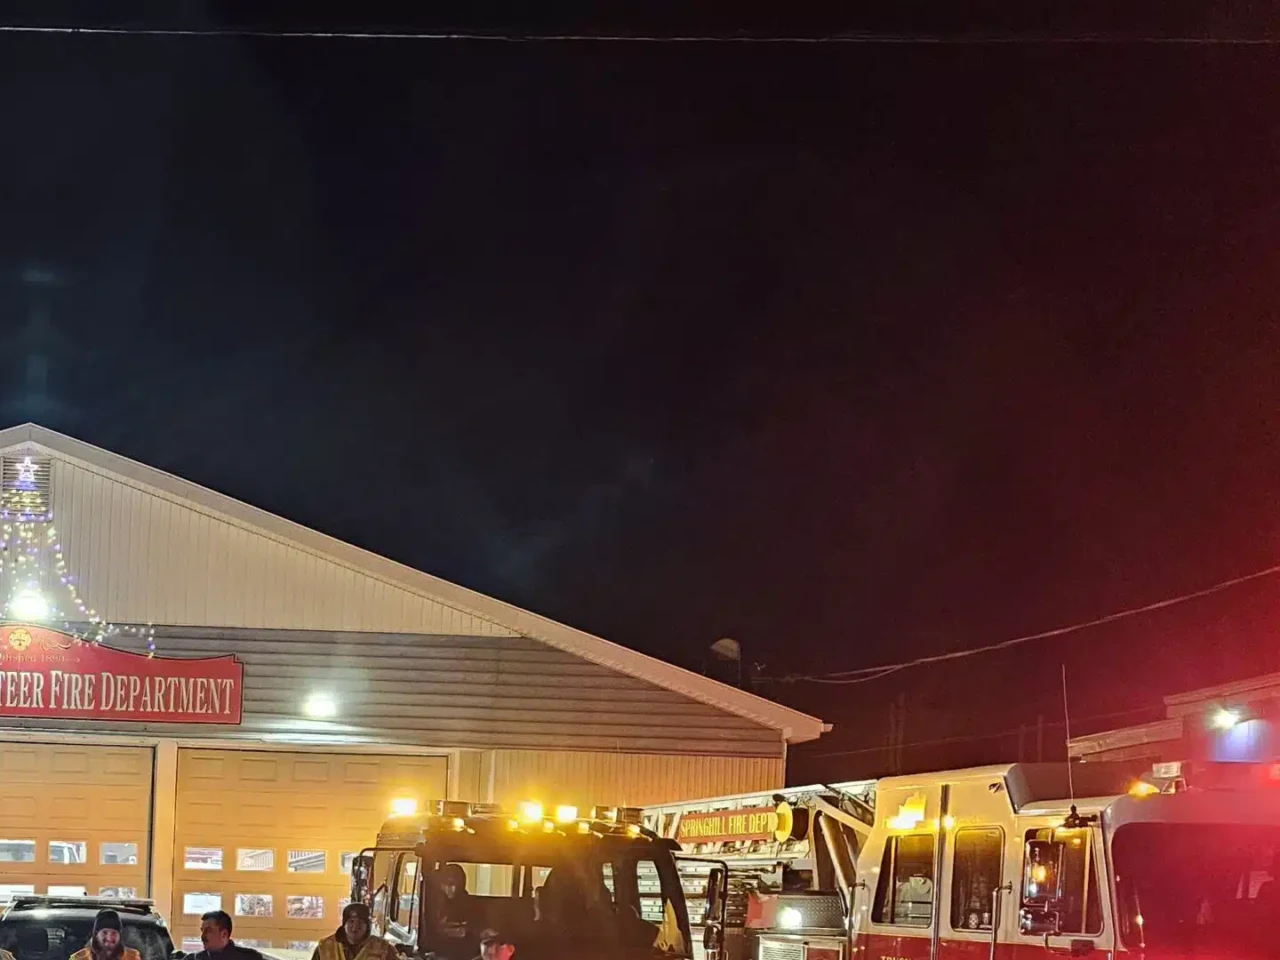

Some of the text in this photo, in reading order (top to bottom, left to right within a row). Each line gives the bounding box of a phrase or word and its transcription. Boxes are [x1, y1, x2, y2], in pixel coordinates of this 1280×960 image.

[49, 670, 96, 710] FIRE
[100, 672, 235, 714] DEPARTMENT
[680, 816, 727, 837] SPRINGHILL
[728, 814, 748, 836] FIRE
